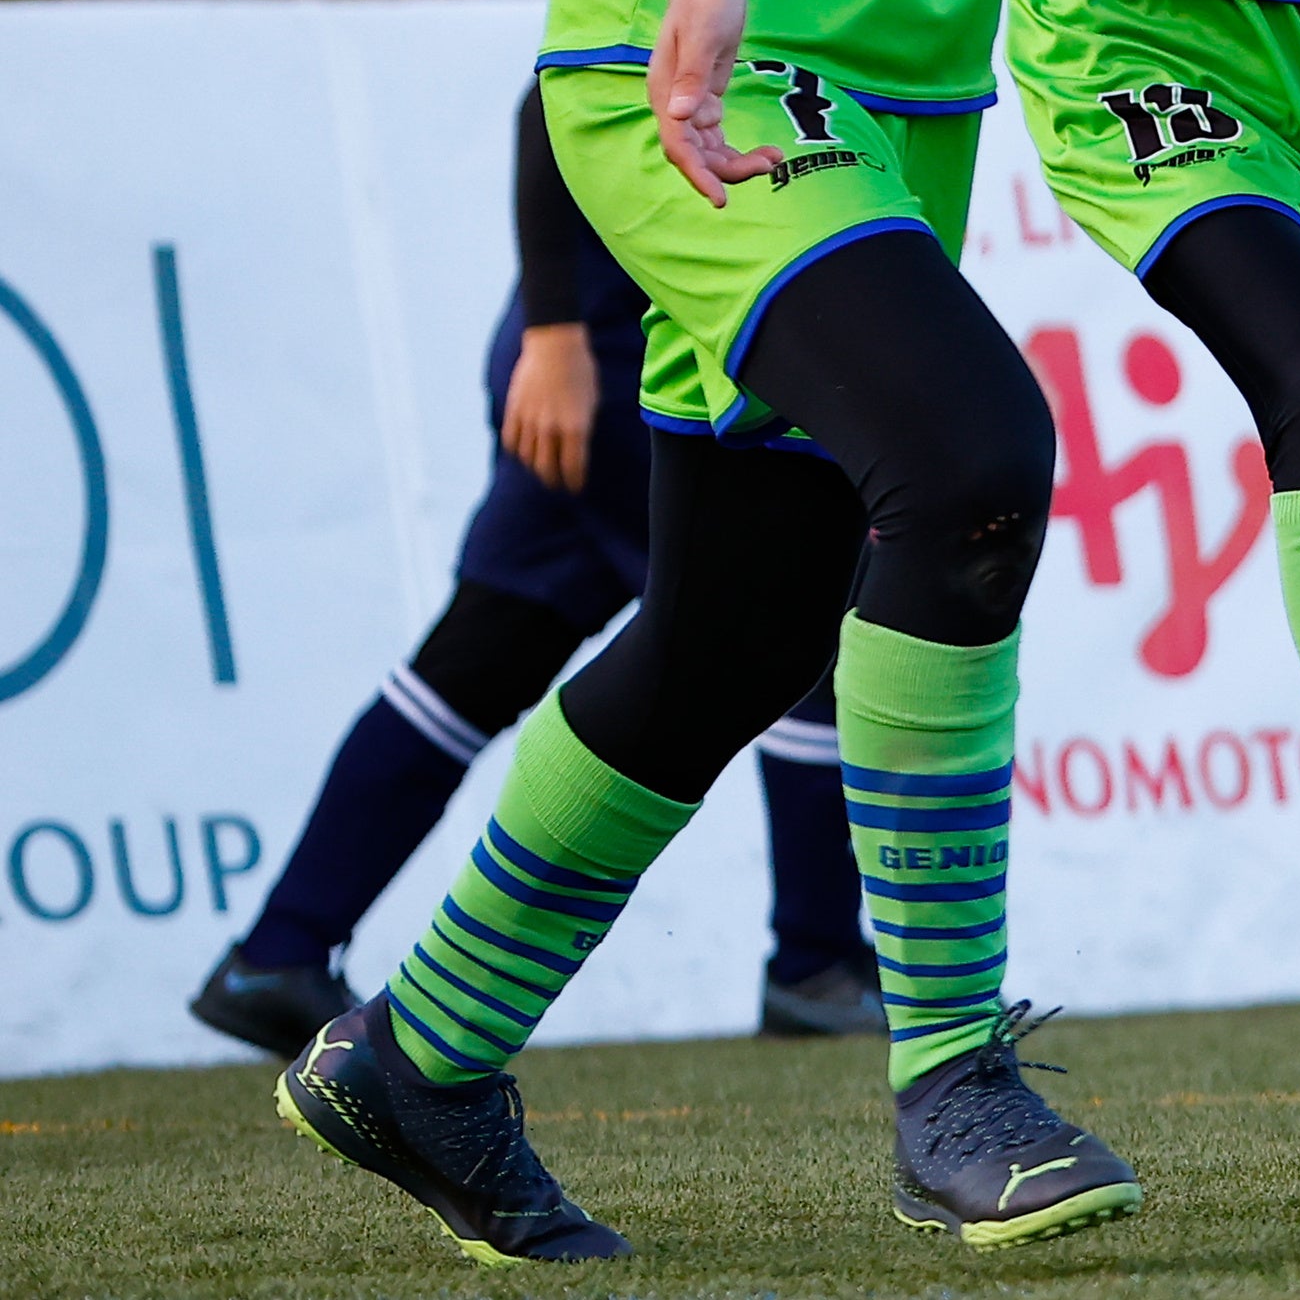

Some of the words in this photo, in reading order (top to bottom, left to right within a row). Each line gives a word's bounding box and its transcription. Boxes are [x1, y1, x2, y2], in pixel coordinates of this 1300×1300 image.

[1097, 82, 1244, 164] 13
[769, 146, 860, 193] genio
[0, 813, 263, 923] OUP
[878, 840, 1009, 871] GENIO
